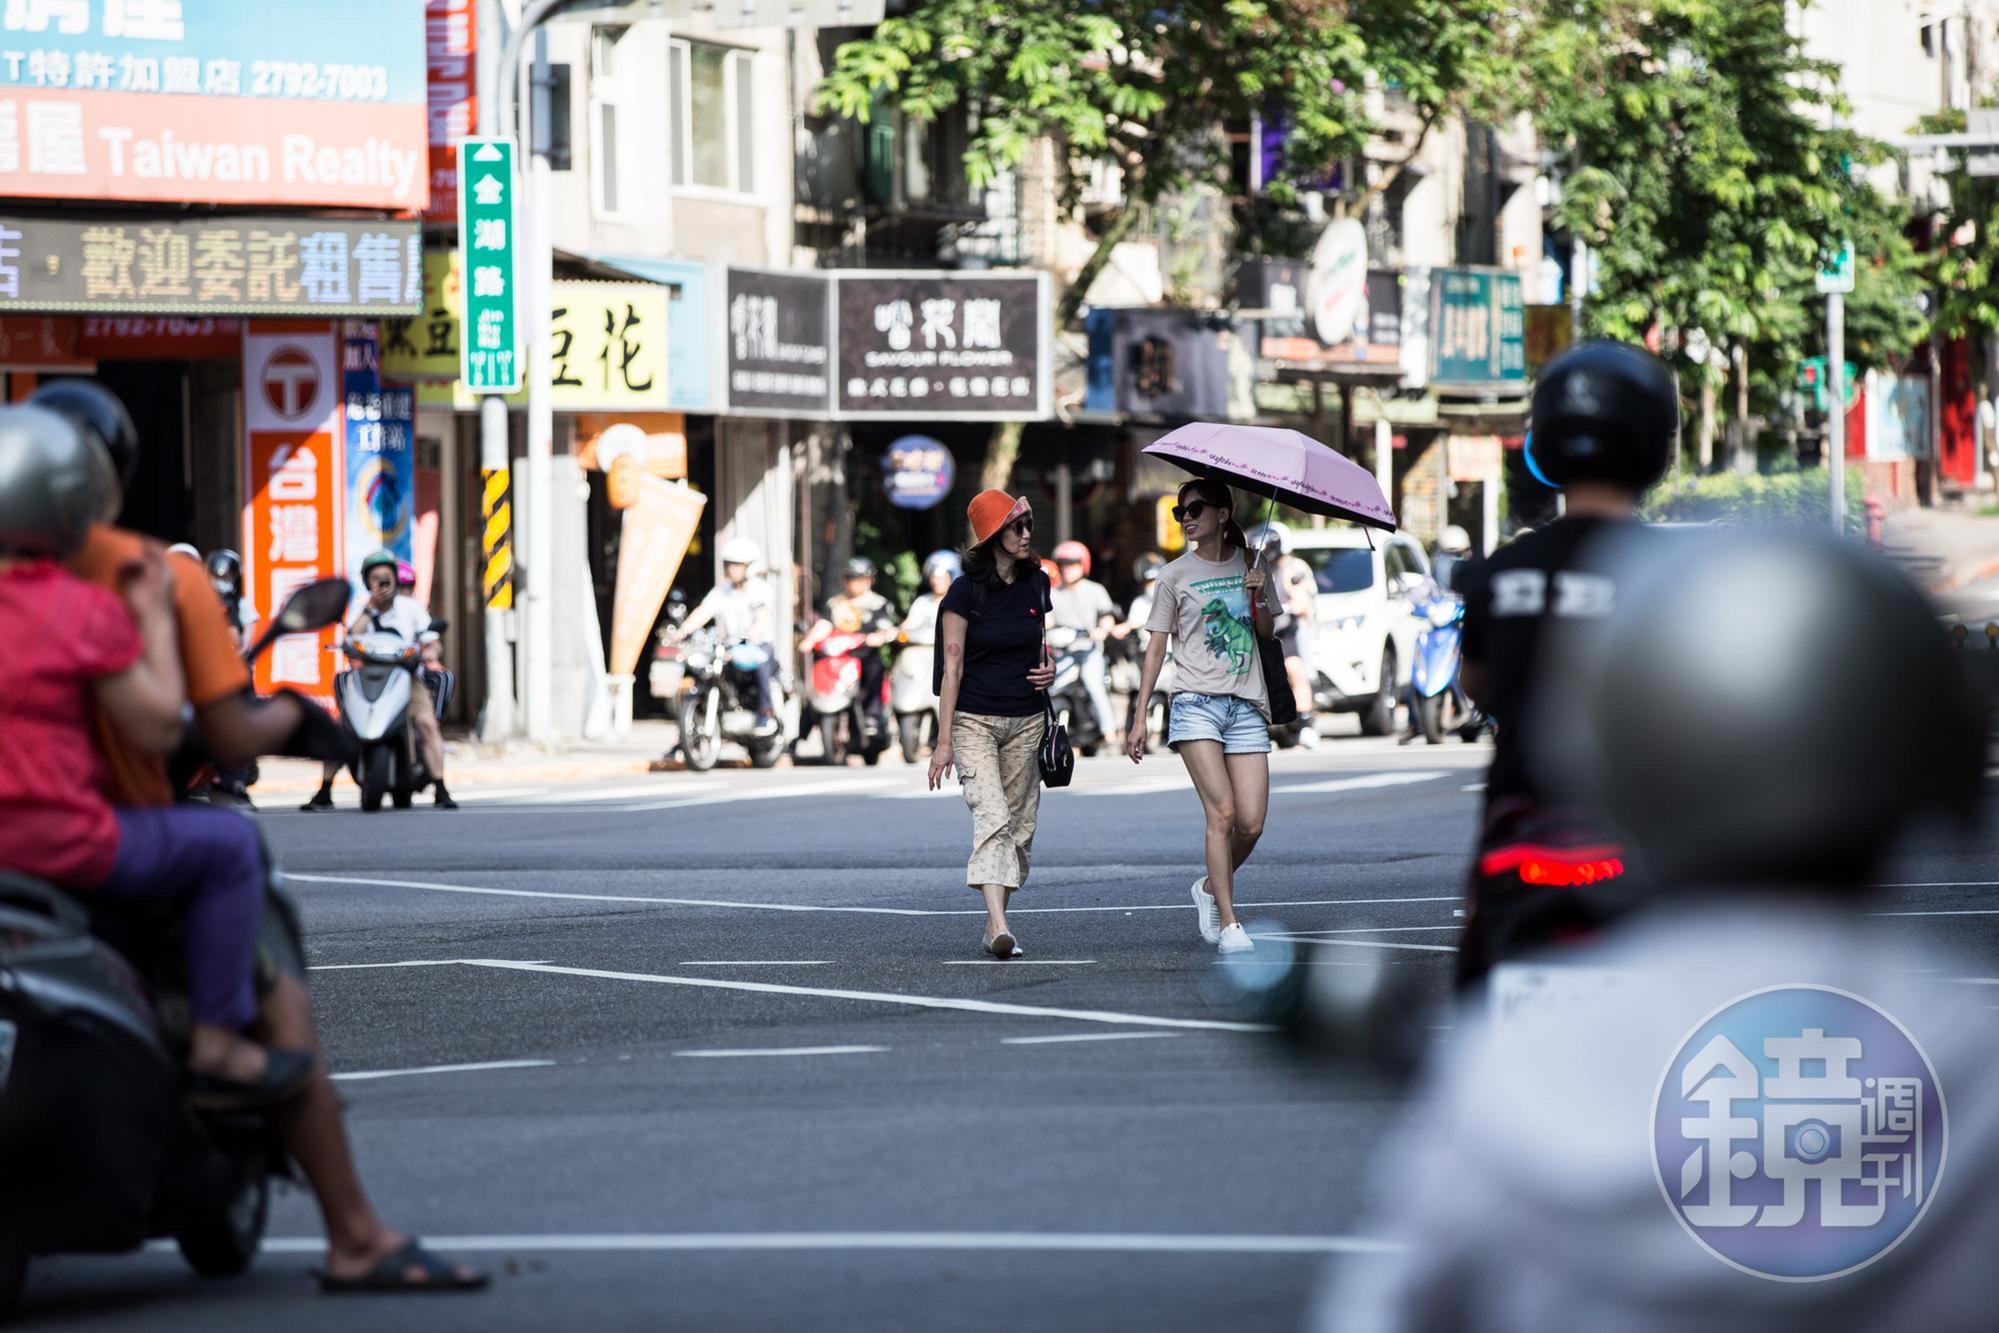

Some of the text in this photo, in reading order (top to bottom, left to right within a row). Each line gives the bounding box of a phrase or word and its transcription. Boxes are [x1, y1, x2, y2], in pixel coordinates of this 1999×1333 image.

[251, 61, 388, 99] 2792-7003
[98, 126, 270, 180] Taiwan
[281, 134, 418, 197] Realty
